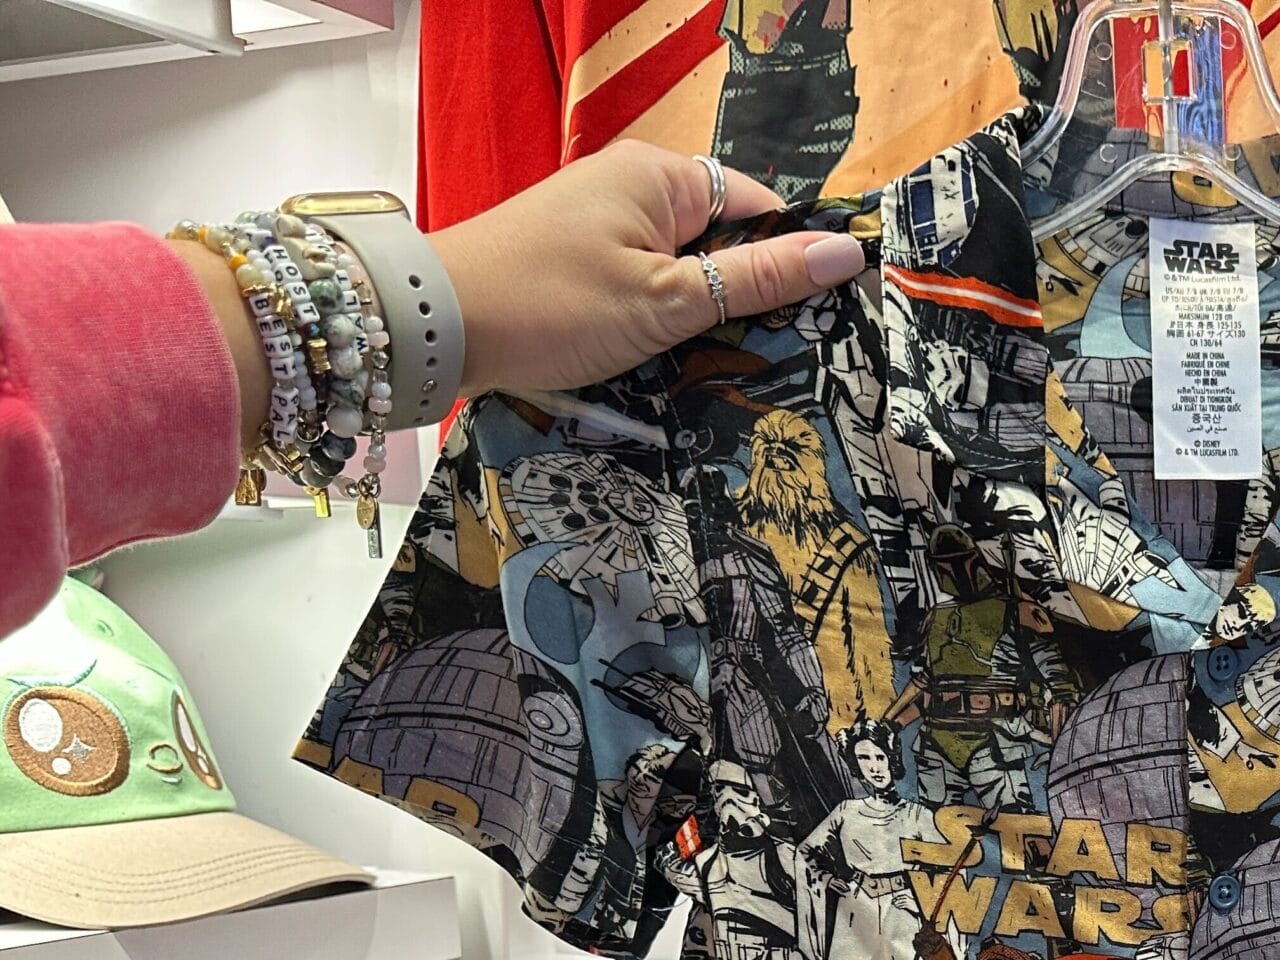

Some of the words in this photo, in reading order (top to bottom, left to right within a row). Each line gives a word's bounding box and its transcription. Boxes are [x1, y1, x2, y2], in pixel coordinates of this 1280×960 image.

[1164, 240, 1239, 259] STAR
[1164, 256, 1239, 274] WARS
[1186, 352, 1200, 360] MADE
[1209, 352, 1225, 360] CHINA
[1215, 361, 1230, 369] CHINE
[1185, 369, 1202, 377] HECHO
[900, 804, 1188, 887] STAR
[905, 869, 1190, 945] WARS
